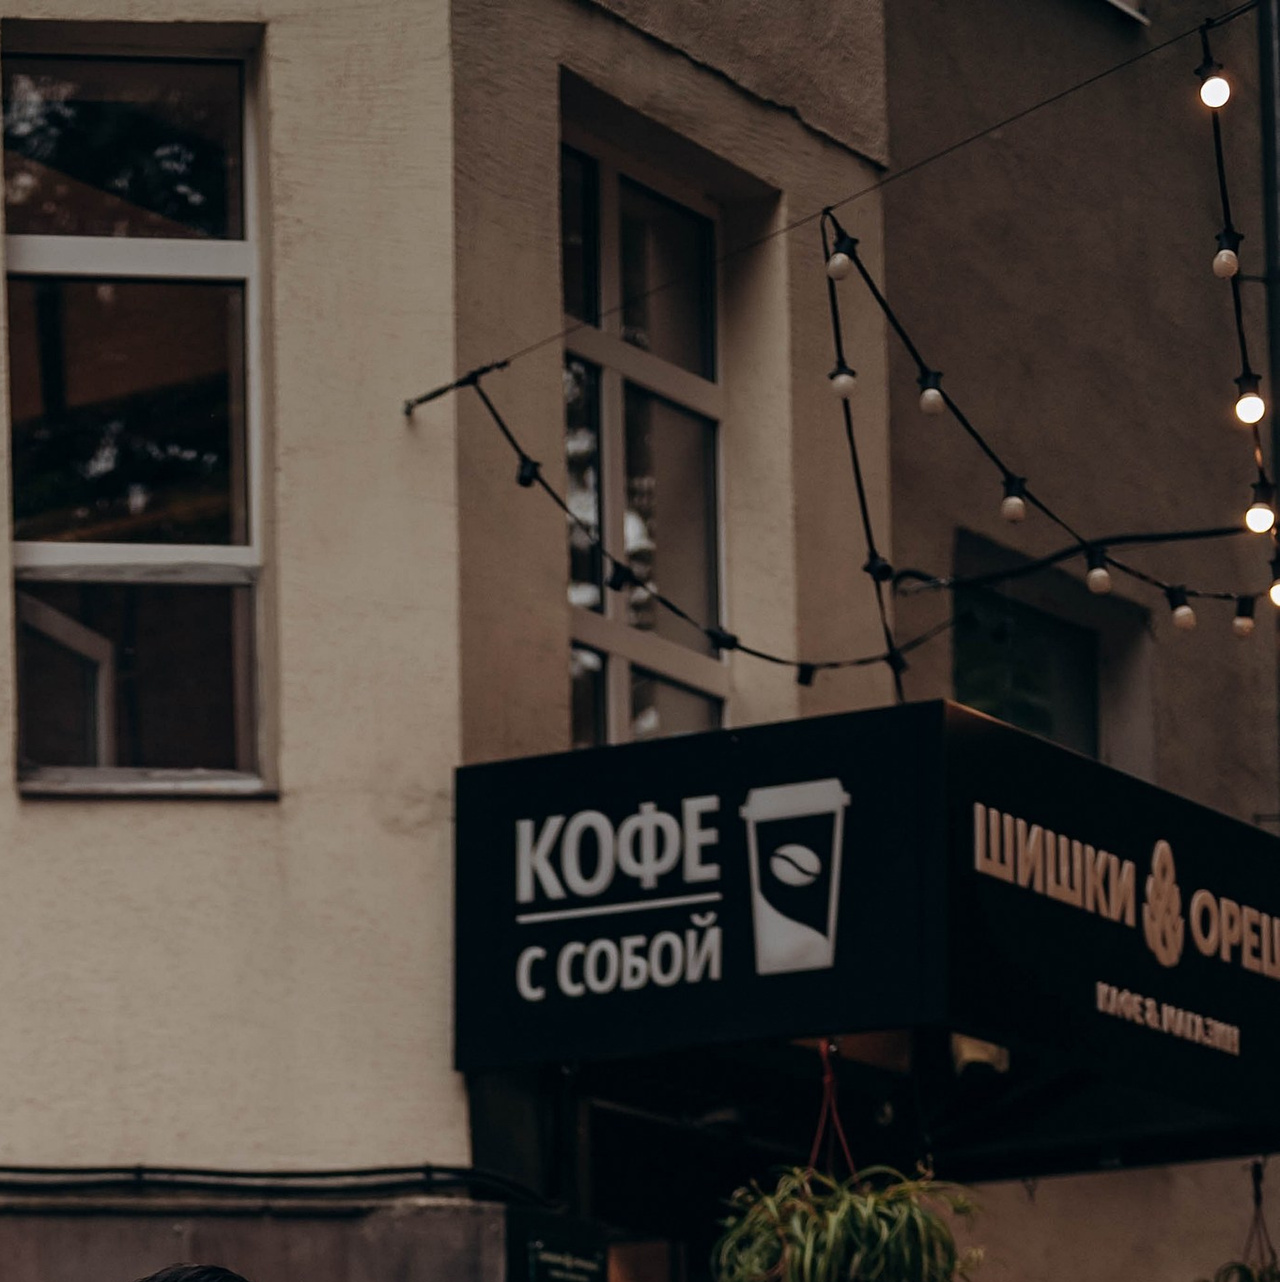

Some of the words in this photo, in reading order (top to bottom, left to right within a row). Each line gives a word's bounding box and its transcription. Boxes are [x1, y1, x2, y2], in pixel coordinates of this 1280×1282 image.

[515, 794, 722, 904] КОФЕ
[973, 800, 1137, 929] ШИШКИ
[515, 945, 548, 1002] С
[556, 910, 723, 998] СОБОЙ
